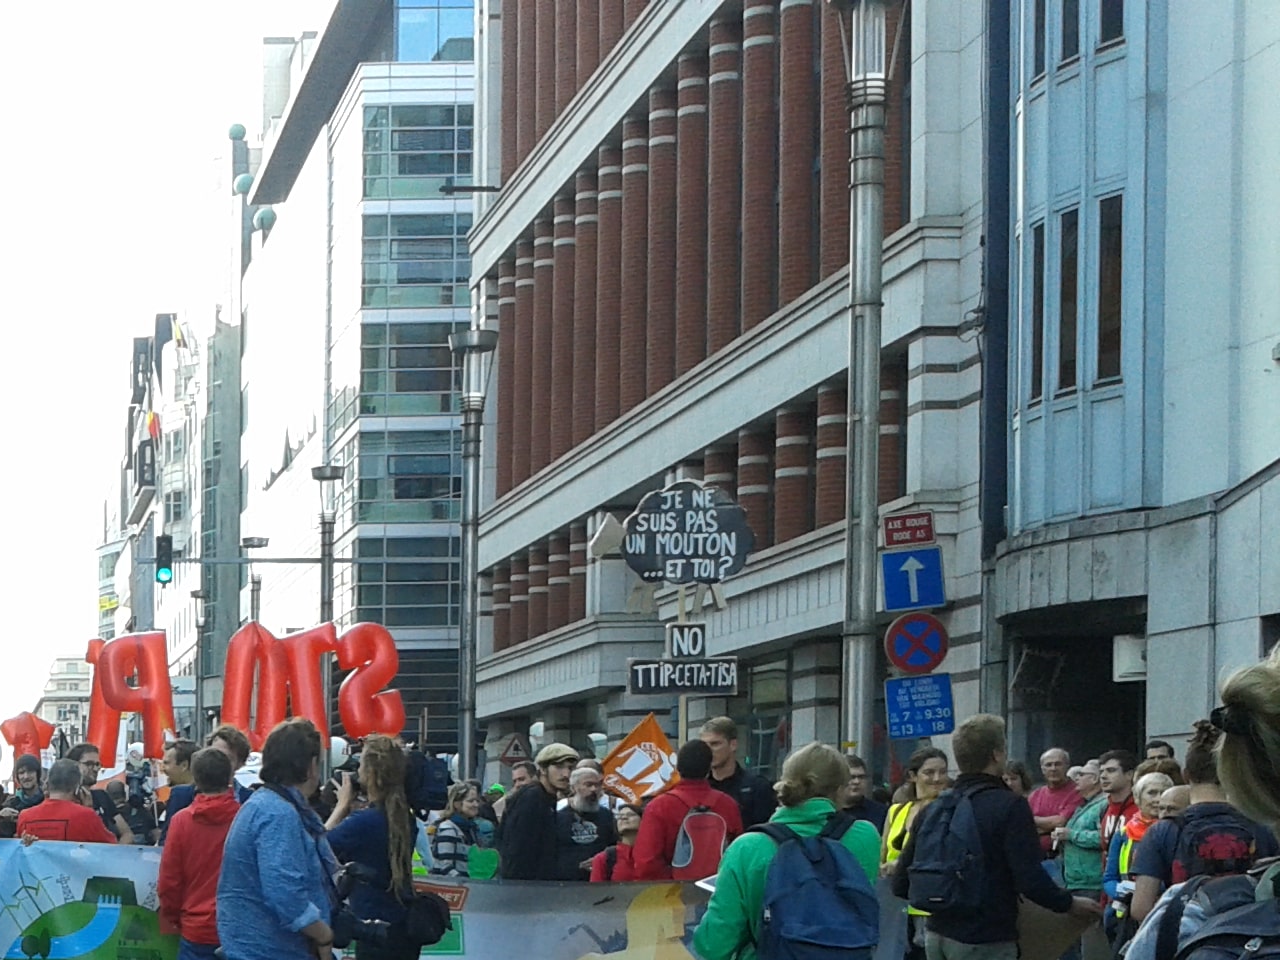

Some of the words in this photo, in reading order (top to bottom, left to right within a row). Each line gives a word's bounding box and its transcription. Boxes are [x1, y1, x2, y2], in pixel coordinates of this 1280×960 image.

[660, 490, 683, 510] JE
[692, 489, 715, 508] NE
[636, 511, 677, 532] SUIS
[686, 509, 718, 533] PAS
[625, 533, 646, 554] UN
[655, 532, 736, 556] MOUTON
[672, 627, 703, 656] NO
[902, 711, 911, 722] 7
[901, 723, 914, 736] 13
[932, 720, 945, 732] 18
